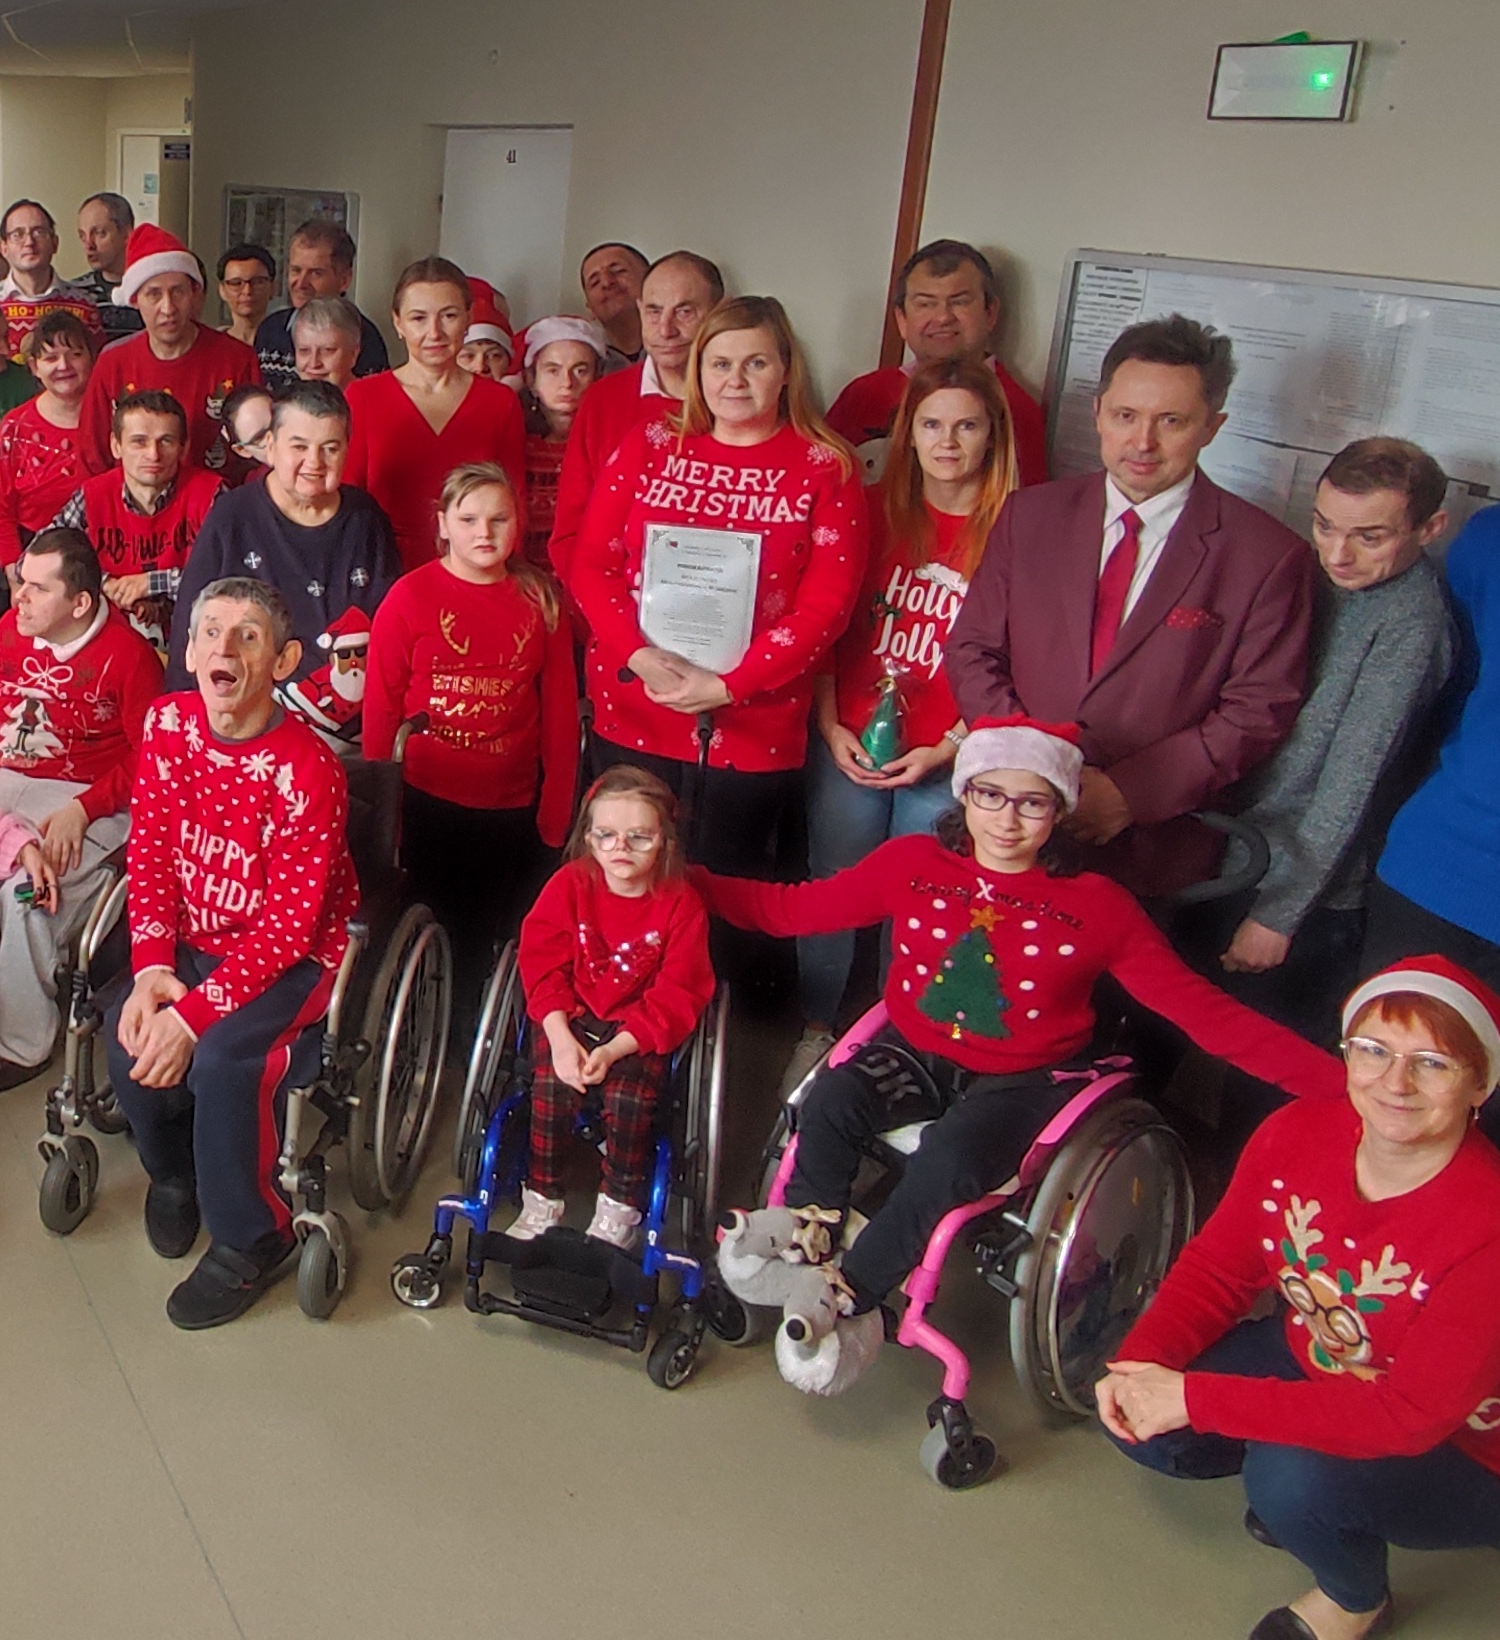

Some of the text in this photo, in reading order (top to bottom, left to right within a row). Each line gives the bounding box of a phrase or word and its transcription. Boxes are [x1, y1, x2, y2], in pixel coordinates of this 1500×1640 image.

[506, 149, 516, 163] 41
[661, 455, 787, 493] MERRY
[885, 565, 964, 634] Holly
[872, 611, 944, 680] Jolly
